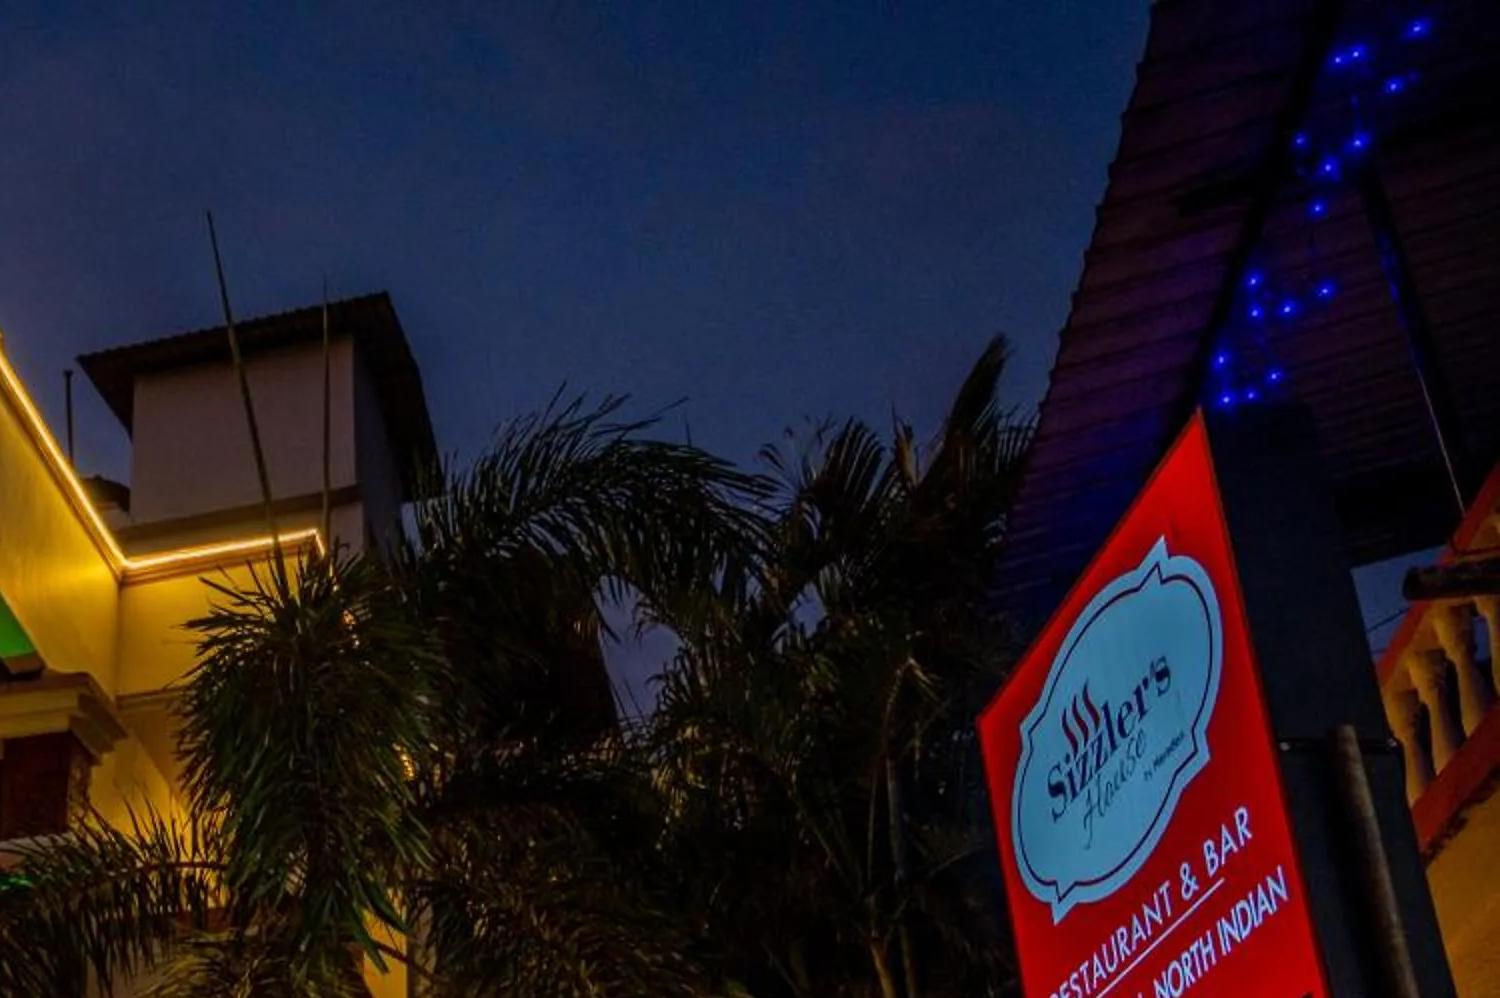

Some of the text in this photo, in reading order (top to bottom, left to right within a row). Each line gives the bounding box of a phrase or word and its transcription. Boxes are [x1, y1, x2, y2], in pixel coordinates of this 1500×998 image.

[1047, 655, 1172, 824] Sizzler's
[1083, 727, 1149, 850] House
[1179, 861, 1199, 901] &
[1203, 806, 1253, 878] BAR
[1215, 864, 1289, 956] INDIAN
